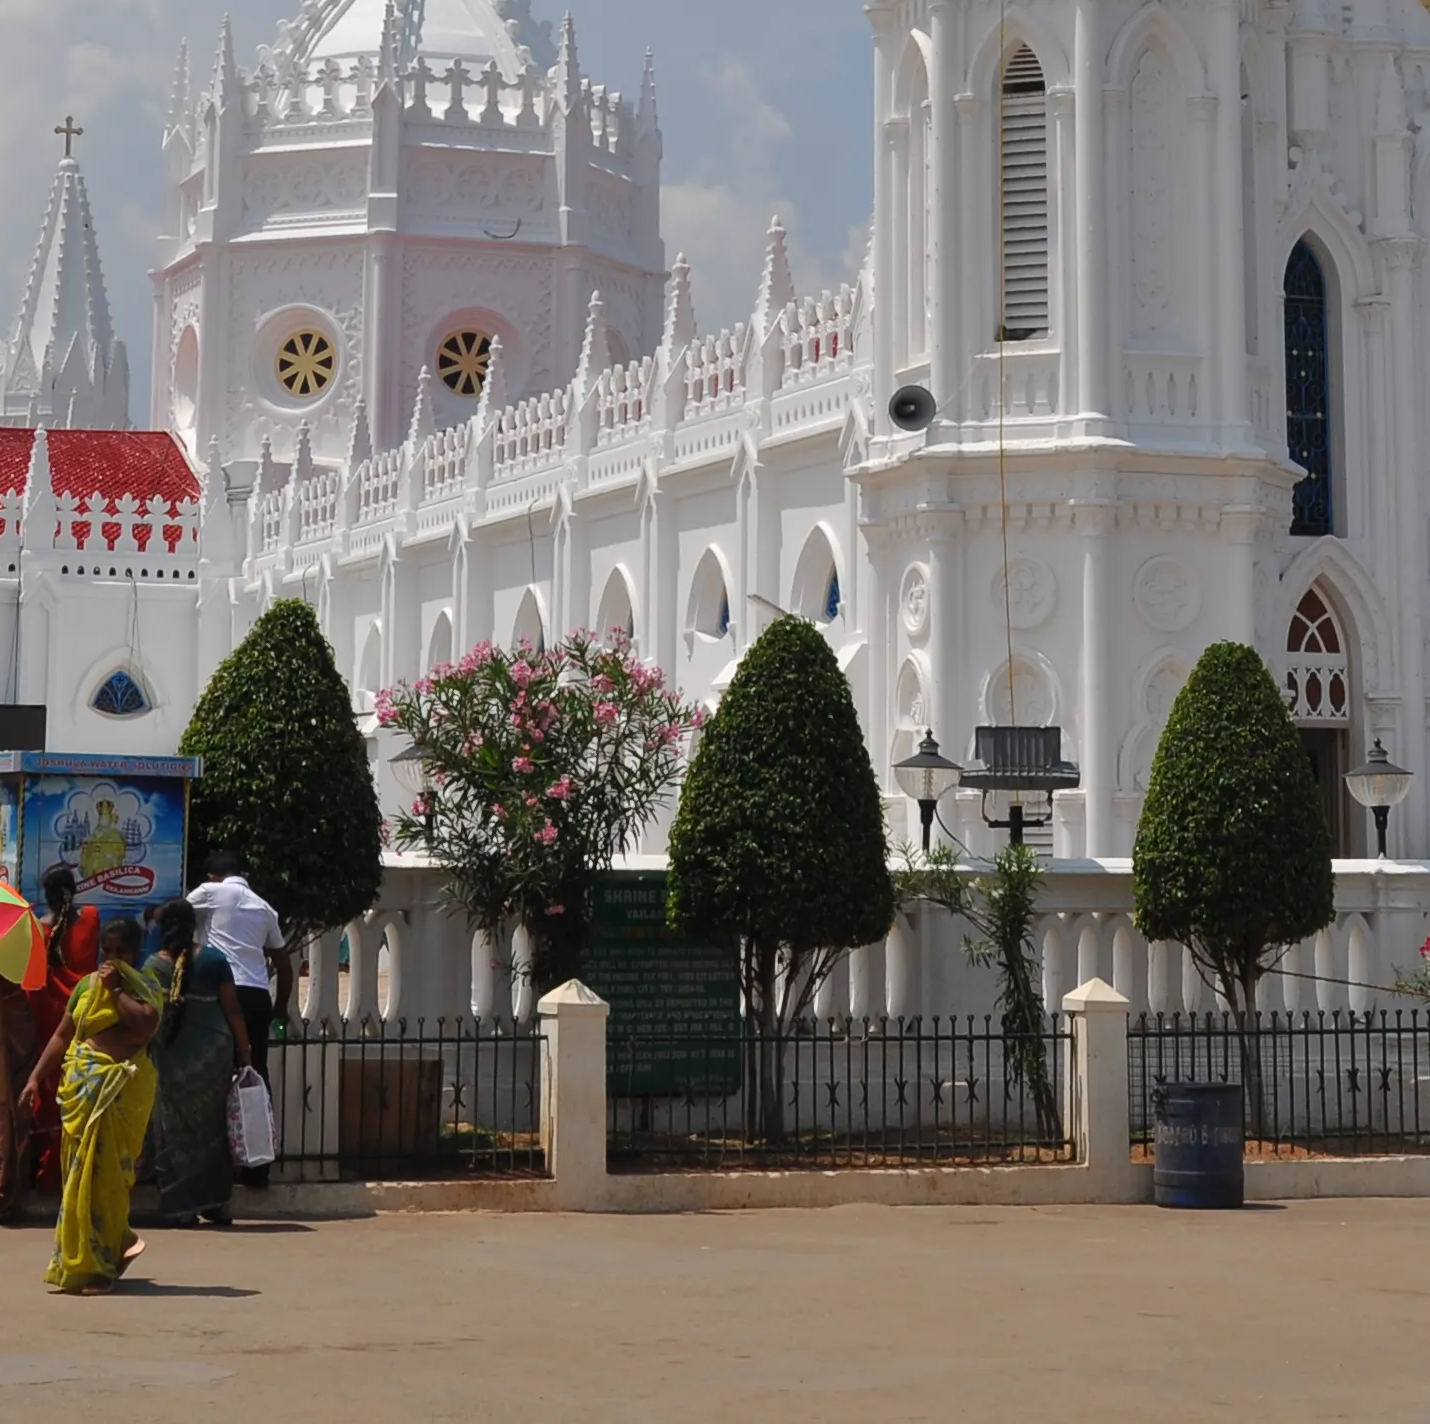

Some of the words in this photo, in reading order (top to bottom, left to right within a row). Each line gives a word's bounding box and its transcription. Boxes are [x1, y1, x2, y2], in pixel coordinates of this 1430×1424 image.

[90, 760, 127, 770] WATER
[132, 761, 192, 772] SOLUTIONS
[97, 866, 141, 883] BASILICA
[604, 889, 657, 904] SHRINE
